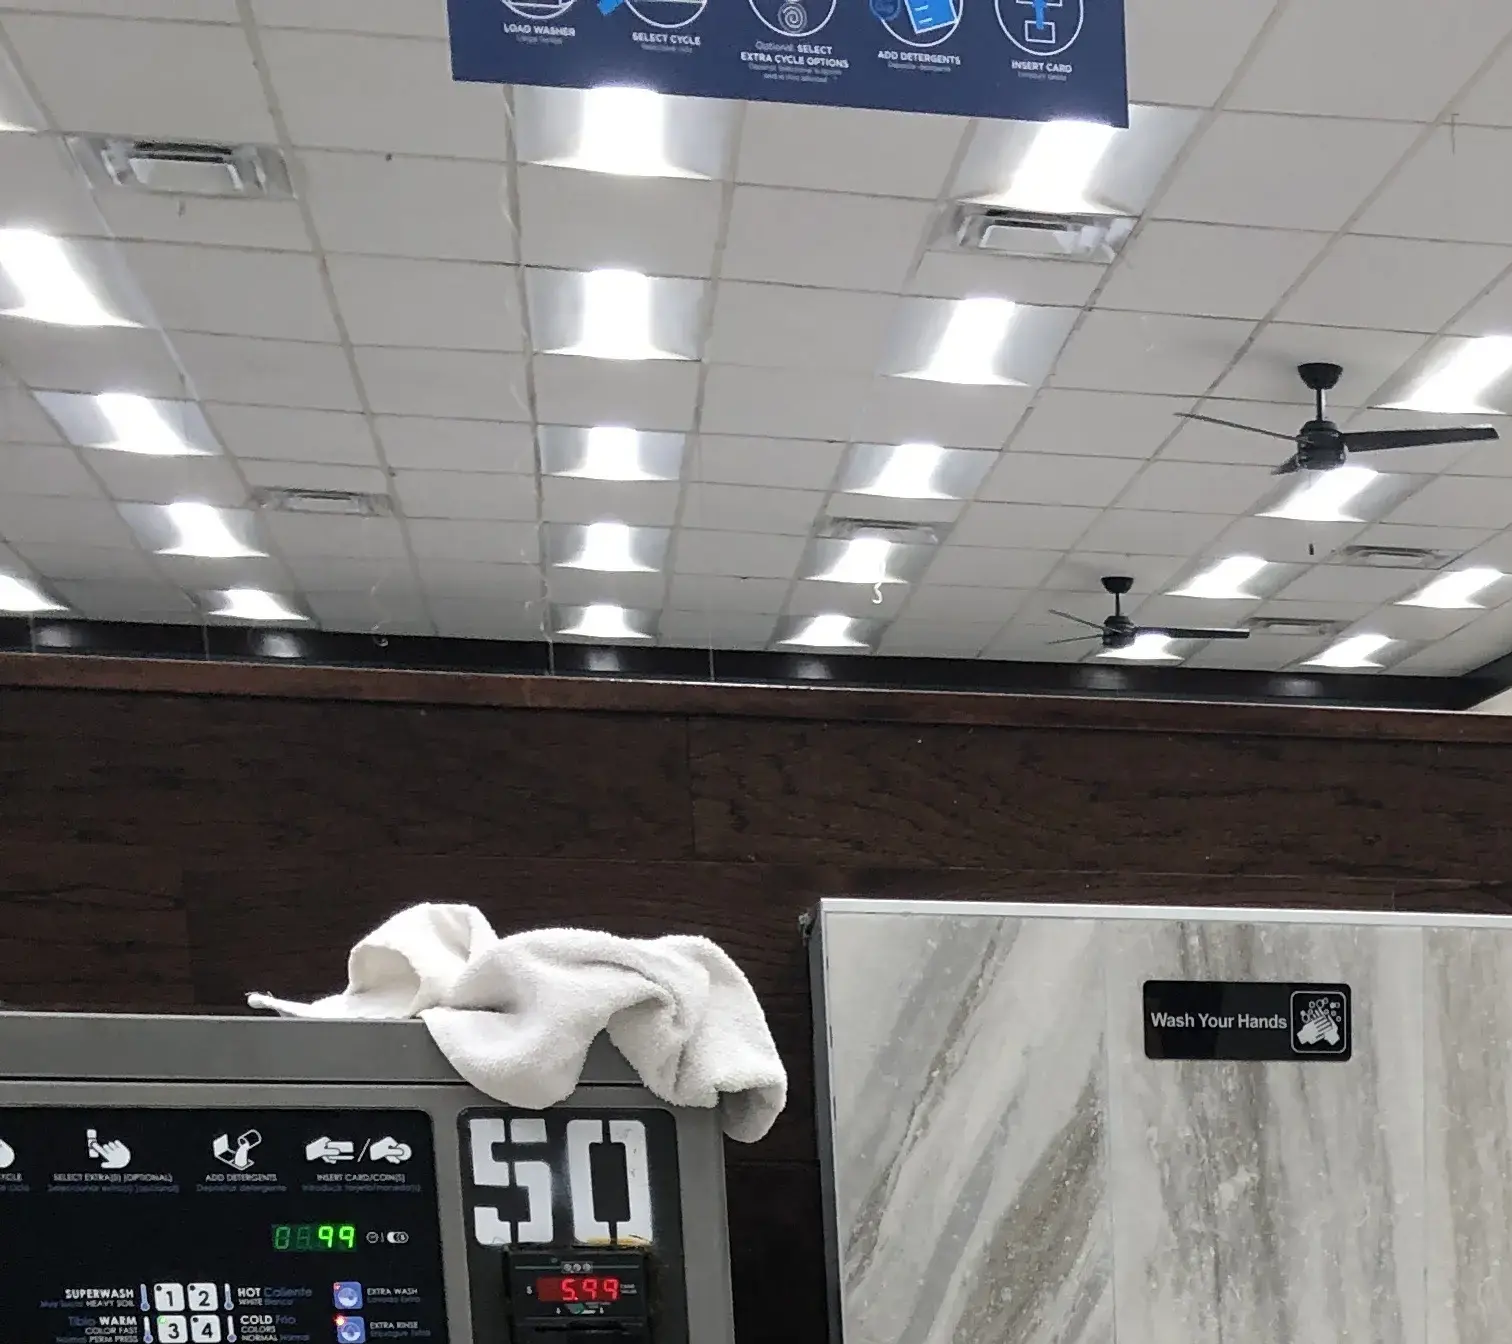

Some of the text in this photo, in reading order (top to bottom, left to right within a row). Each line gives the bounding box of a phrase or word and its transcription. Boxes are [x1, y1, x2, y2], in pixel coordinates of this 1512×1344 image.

[533, 25, 576, 36] WASHER
[632, 31, 701, 46] SELECT CYCLE
[797, 44, 833, 55] SELECT
[740, 51, 772, 63] EXTRA
[774, 54, 805, 65] CYCLE
[807, 57, 850, 69] OPTIONS
[877, 50, 961, 66] ADD DETERGENTS
[1011, 59, 1073, 73] INSERT CARD
[1150, 1012, 1288, 1029] Wash Your Hands
[205, 1173, 277, 1182] ADD DETERGENTS
[316, 1173, 343, 1182] INSERT
[469, 1117, 653, 1245] 50
[64, 1288, 135, 1299] SUPERWASH
[237, 1287, 261, 1298] HOT
[366, 1287, 418, 1296] EXTRA WASH
[561, 1278, 619, 1300] 5.99
[165, 1290, 174, 1307] 1
[198, 1290, 211, 1307] 2
[98, 1316, 138, 1326] WARM
[239, 1314, 273, 1325] COLD
[369, 1321, 395, 1330] EXTRA
[84, 1326, 117, 1335] COLOR
[168, 1322, 180, 1340] 3
[201, 1322, 214, 1339] 4
